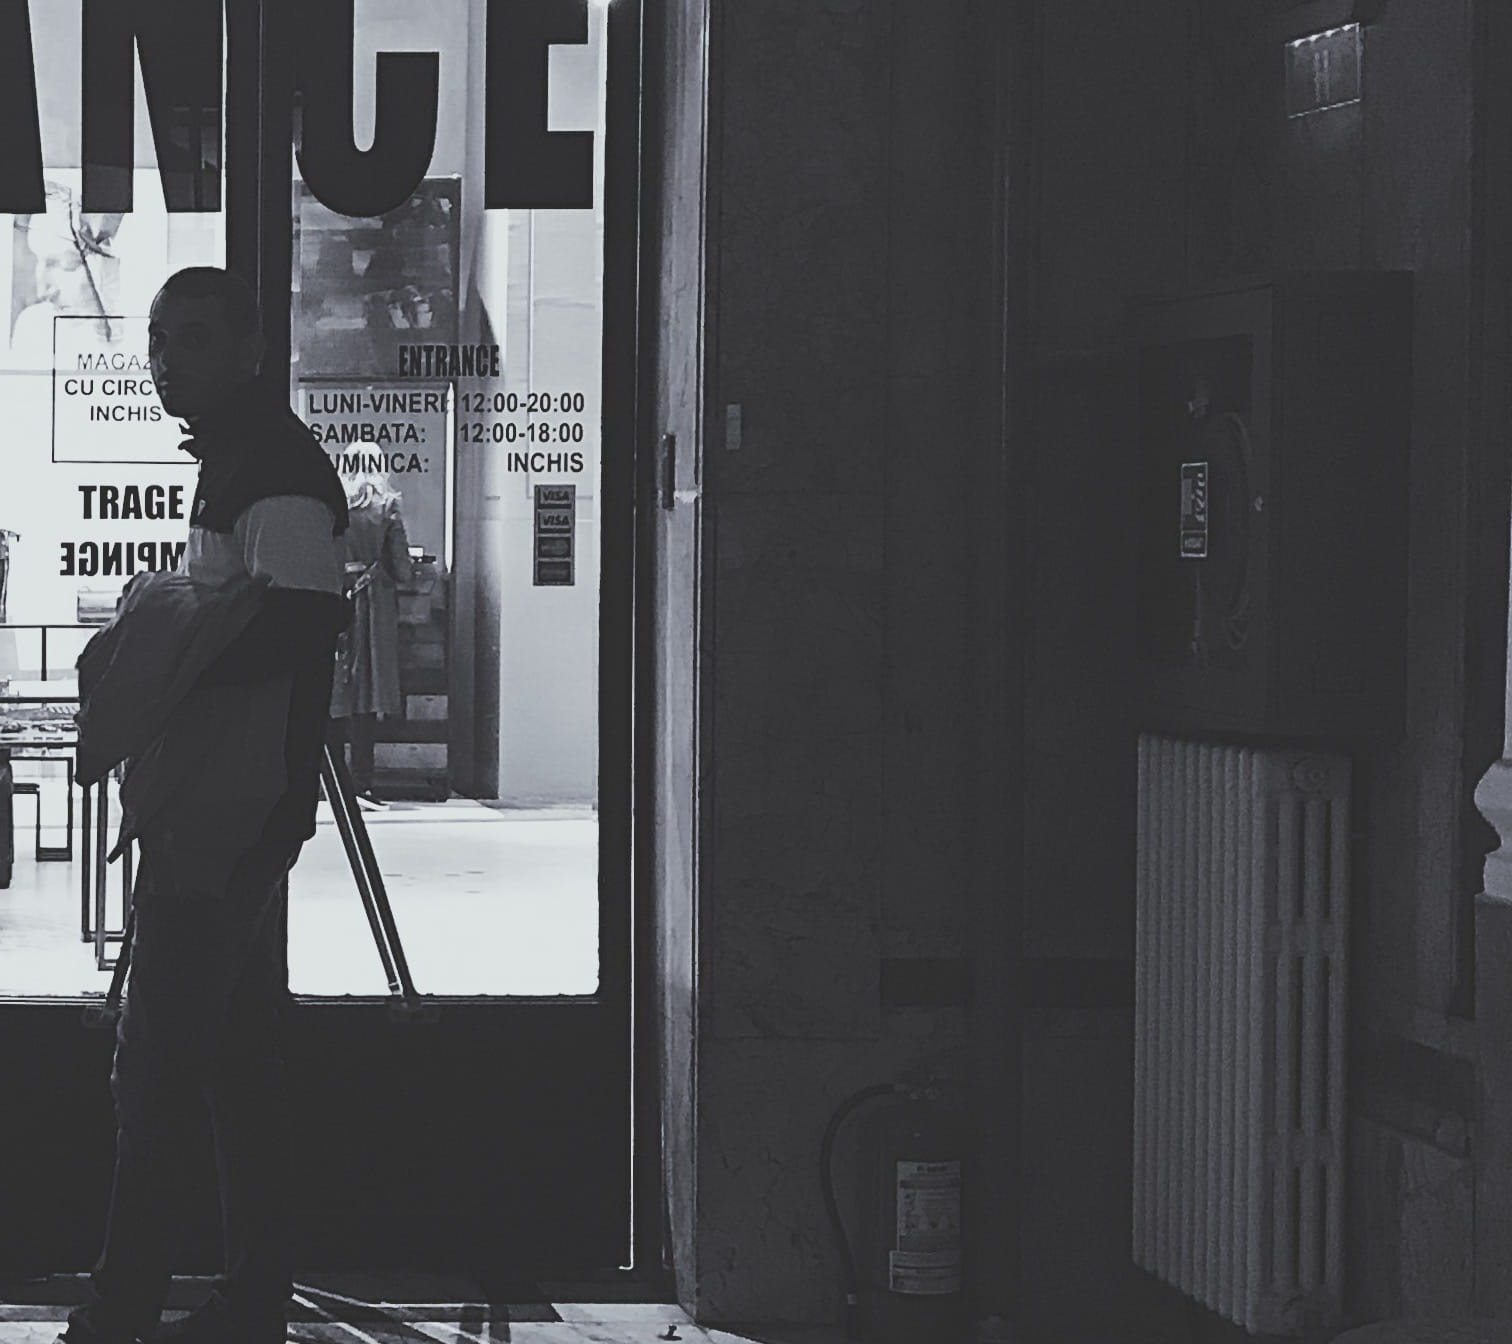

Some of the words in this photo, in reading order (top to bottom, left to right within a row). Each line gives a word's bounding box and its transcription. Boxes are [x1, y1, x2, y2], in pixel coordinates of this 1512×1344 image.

[77, 354, 152, 370] MAGAZ
[399, 345, 500, 377] ENTRANCE
[64, 379, 94, 396] CU
[101, 379, 153, 396] CIRC
[461, 392, 585, 414] 12:00-20:00
[90, 406, 163, 422] INCHIS
[310, 423, 426, 444] SAMBATA:
[460, 423, 584, 444] 12:00-18:00
[507, 453, 584, 473] INCHIS
[78, 485, 184, 519] TRAGE
[543, 490, 570, 502] VISA
[543, 515, 570, 526] VISA
